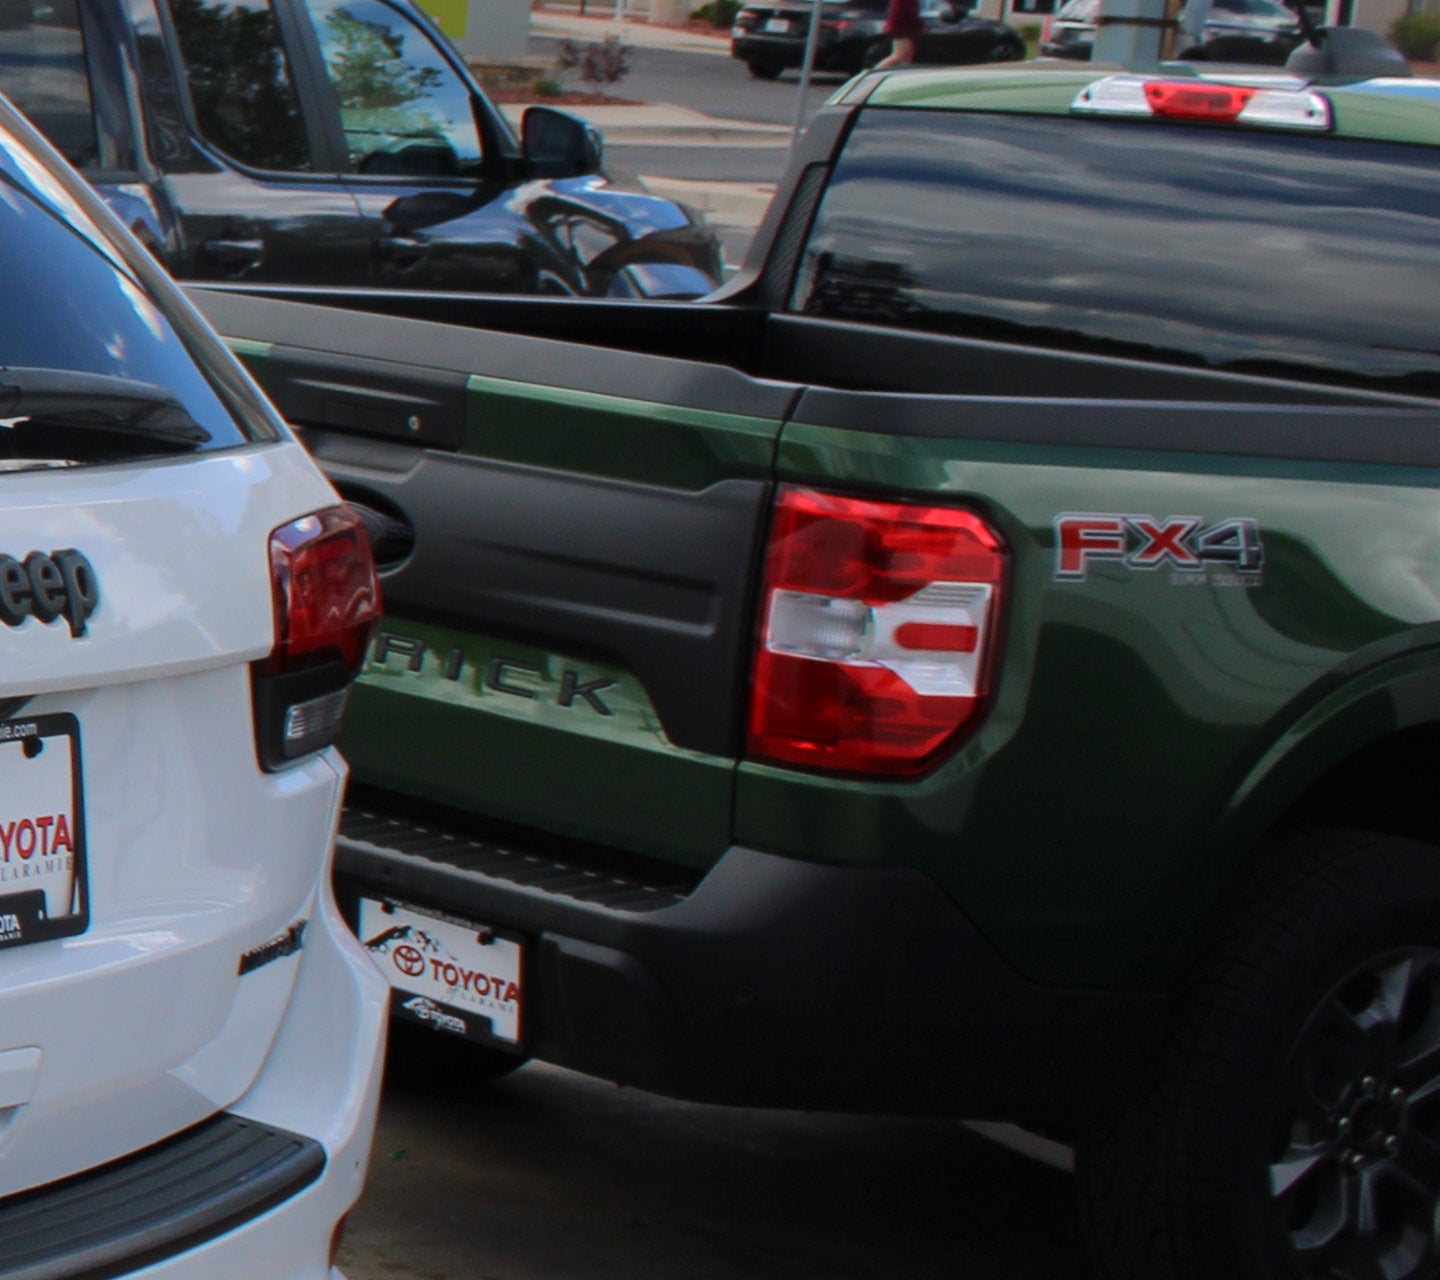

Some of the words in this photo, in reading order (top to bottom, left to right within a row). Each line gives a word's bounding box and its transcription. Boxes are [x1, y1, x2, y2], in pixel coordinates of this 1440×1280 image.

[1052, 511, 1265, 583] FX4
[374, 632, 619, 717] RICK
[429, 958, 521, 1002] TOYOTA
